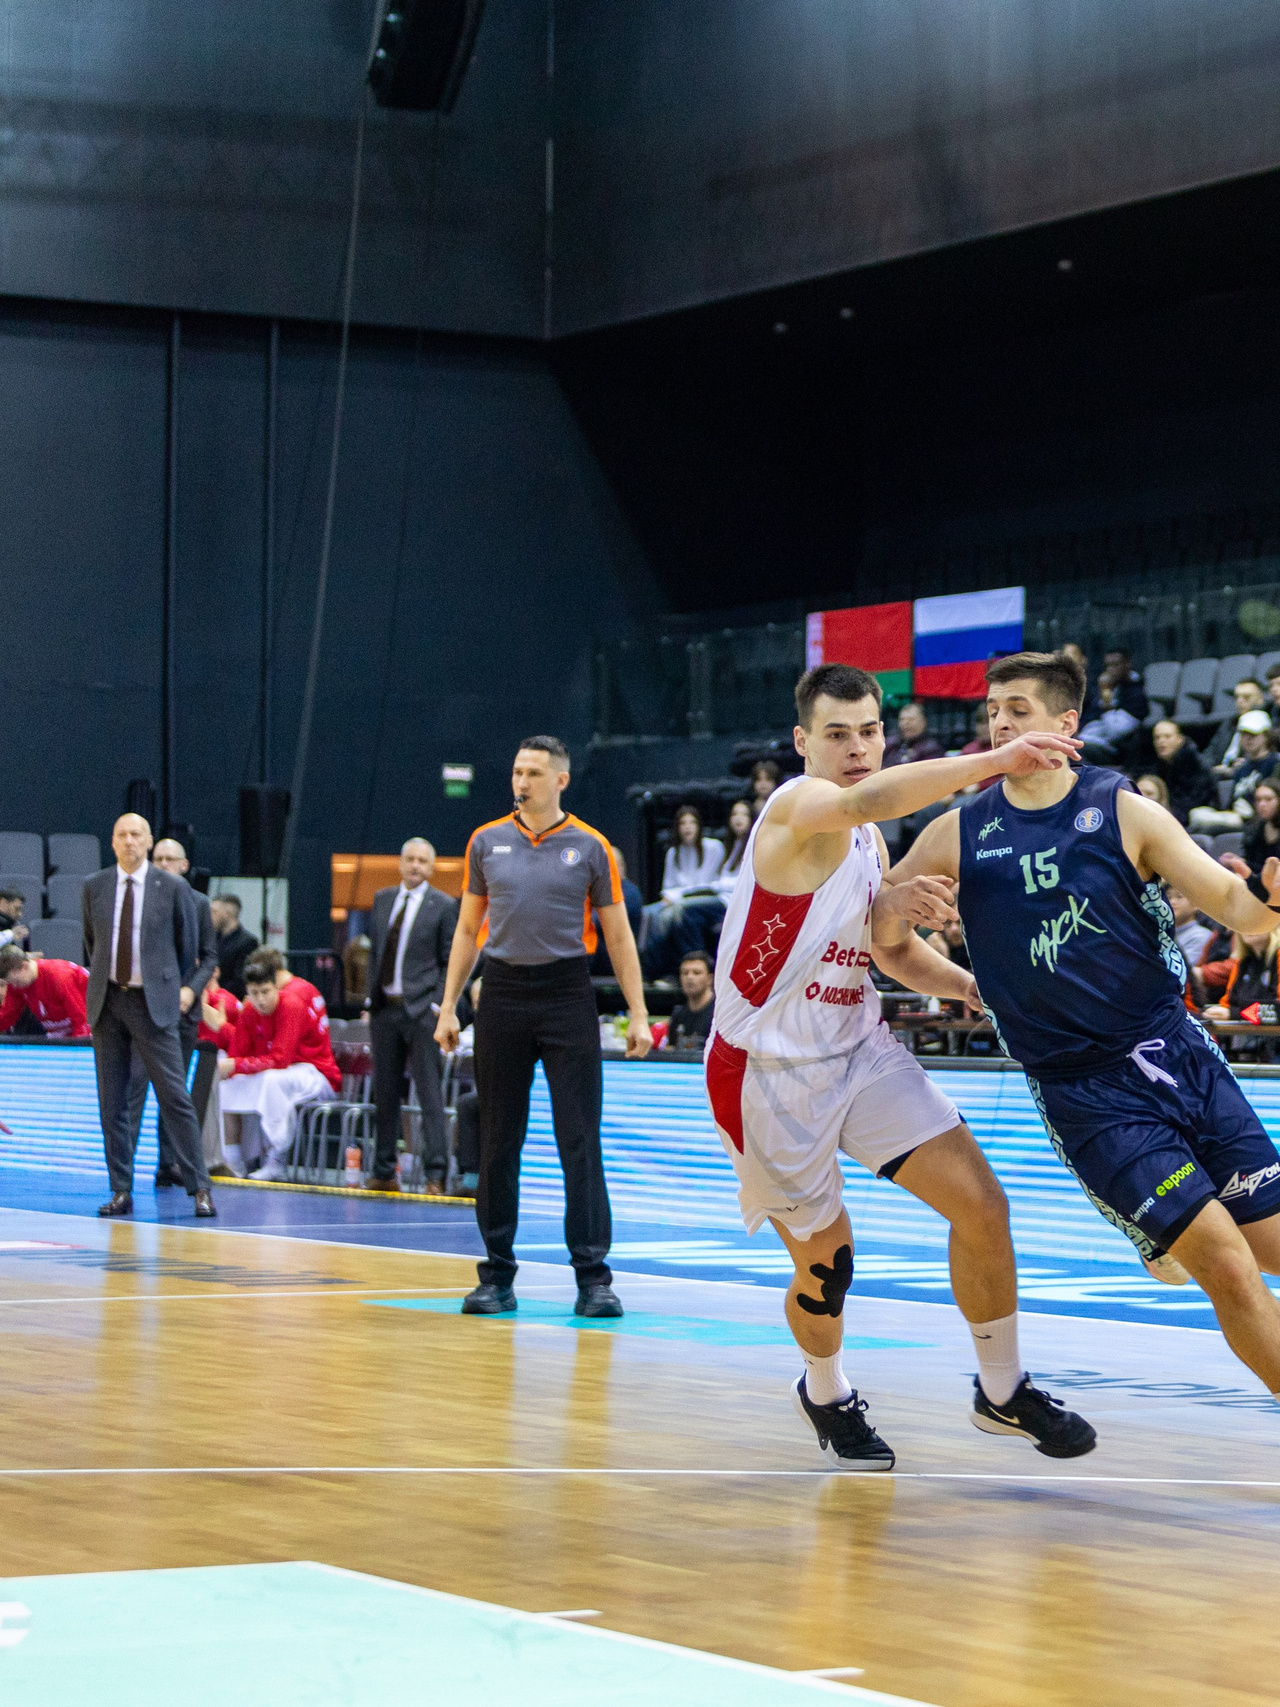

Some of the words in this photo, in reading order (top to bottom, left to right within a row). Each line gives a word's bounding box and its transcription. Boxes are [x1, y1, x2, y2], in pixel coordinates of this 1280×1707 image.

[976, 847, 1013, 860] Kempa
[1019, 847, 1060, 894] 15
[1130, 1196, 1156, 1222] empa
